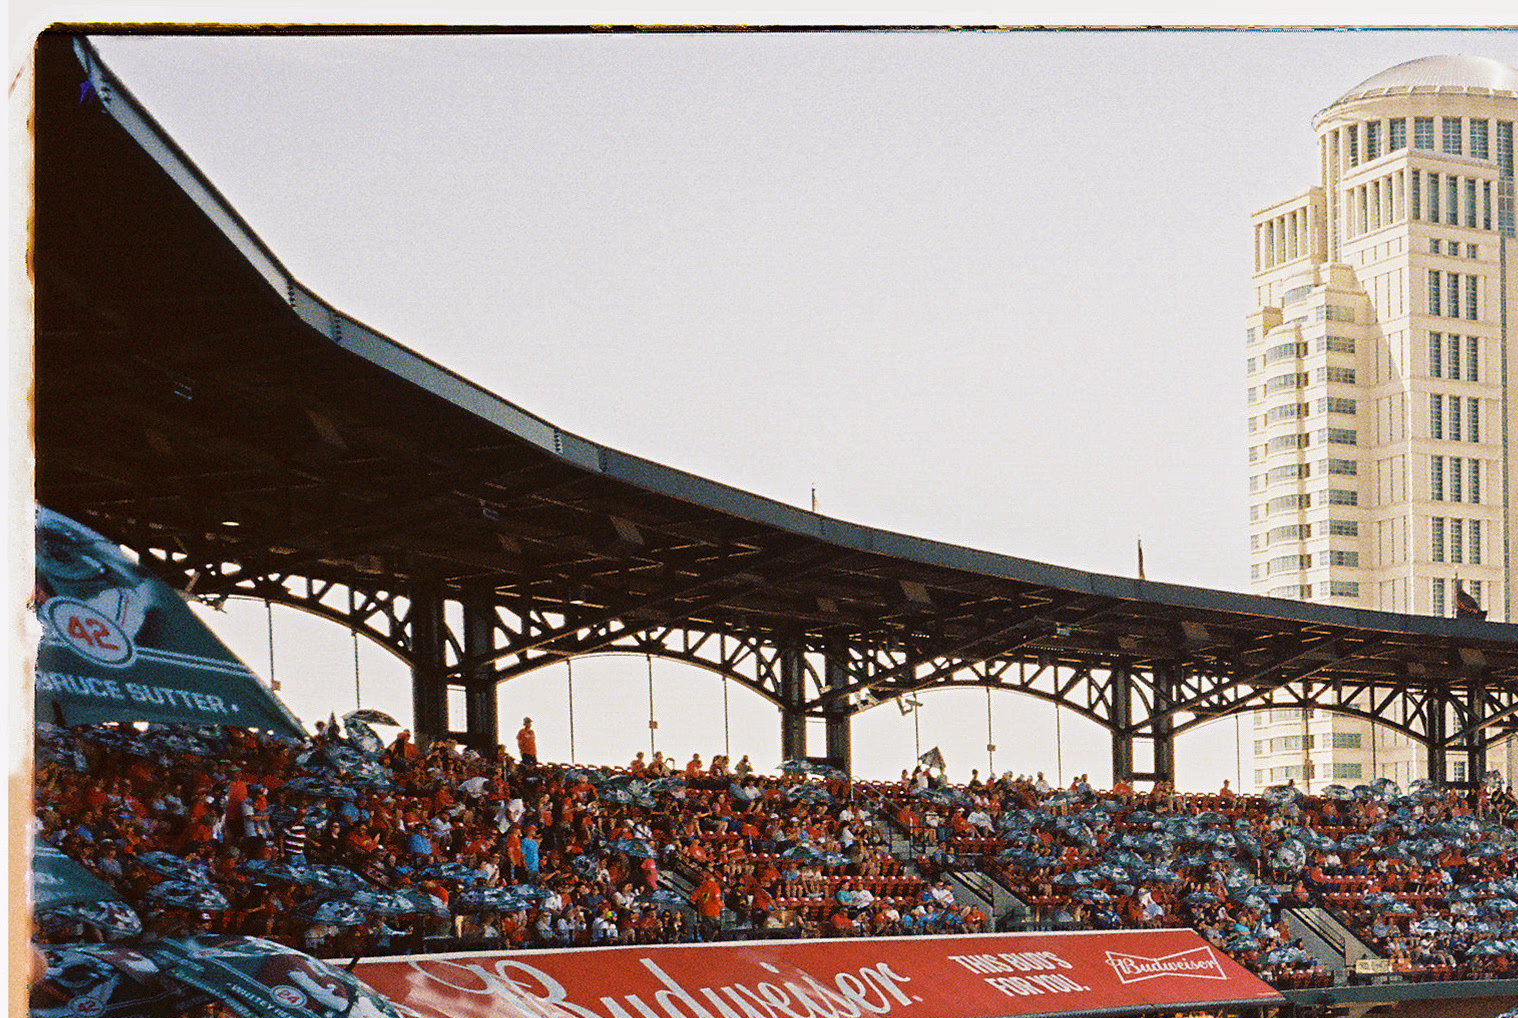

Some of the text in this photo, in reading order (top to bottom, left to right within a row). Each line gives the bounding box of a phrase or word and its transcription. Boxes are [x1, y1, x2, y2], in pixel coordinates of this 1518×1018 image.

[67, 615, 119, 651] 42
[125, 683, 228, 715] SUTTER
[947, 951, 1074, 974] THIS BUD'S
[1106, 956, 1218, 976] Budweiser
[983, 973, 1092, 997] FOR YOU.
